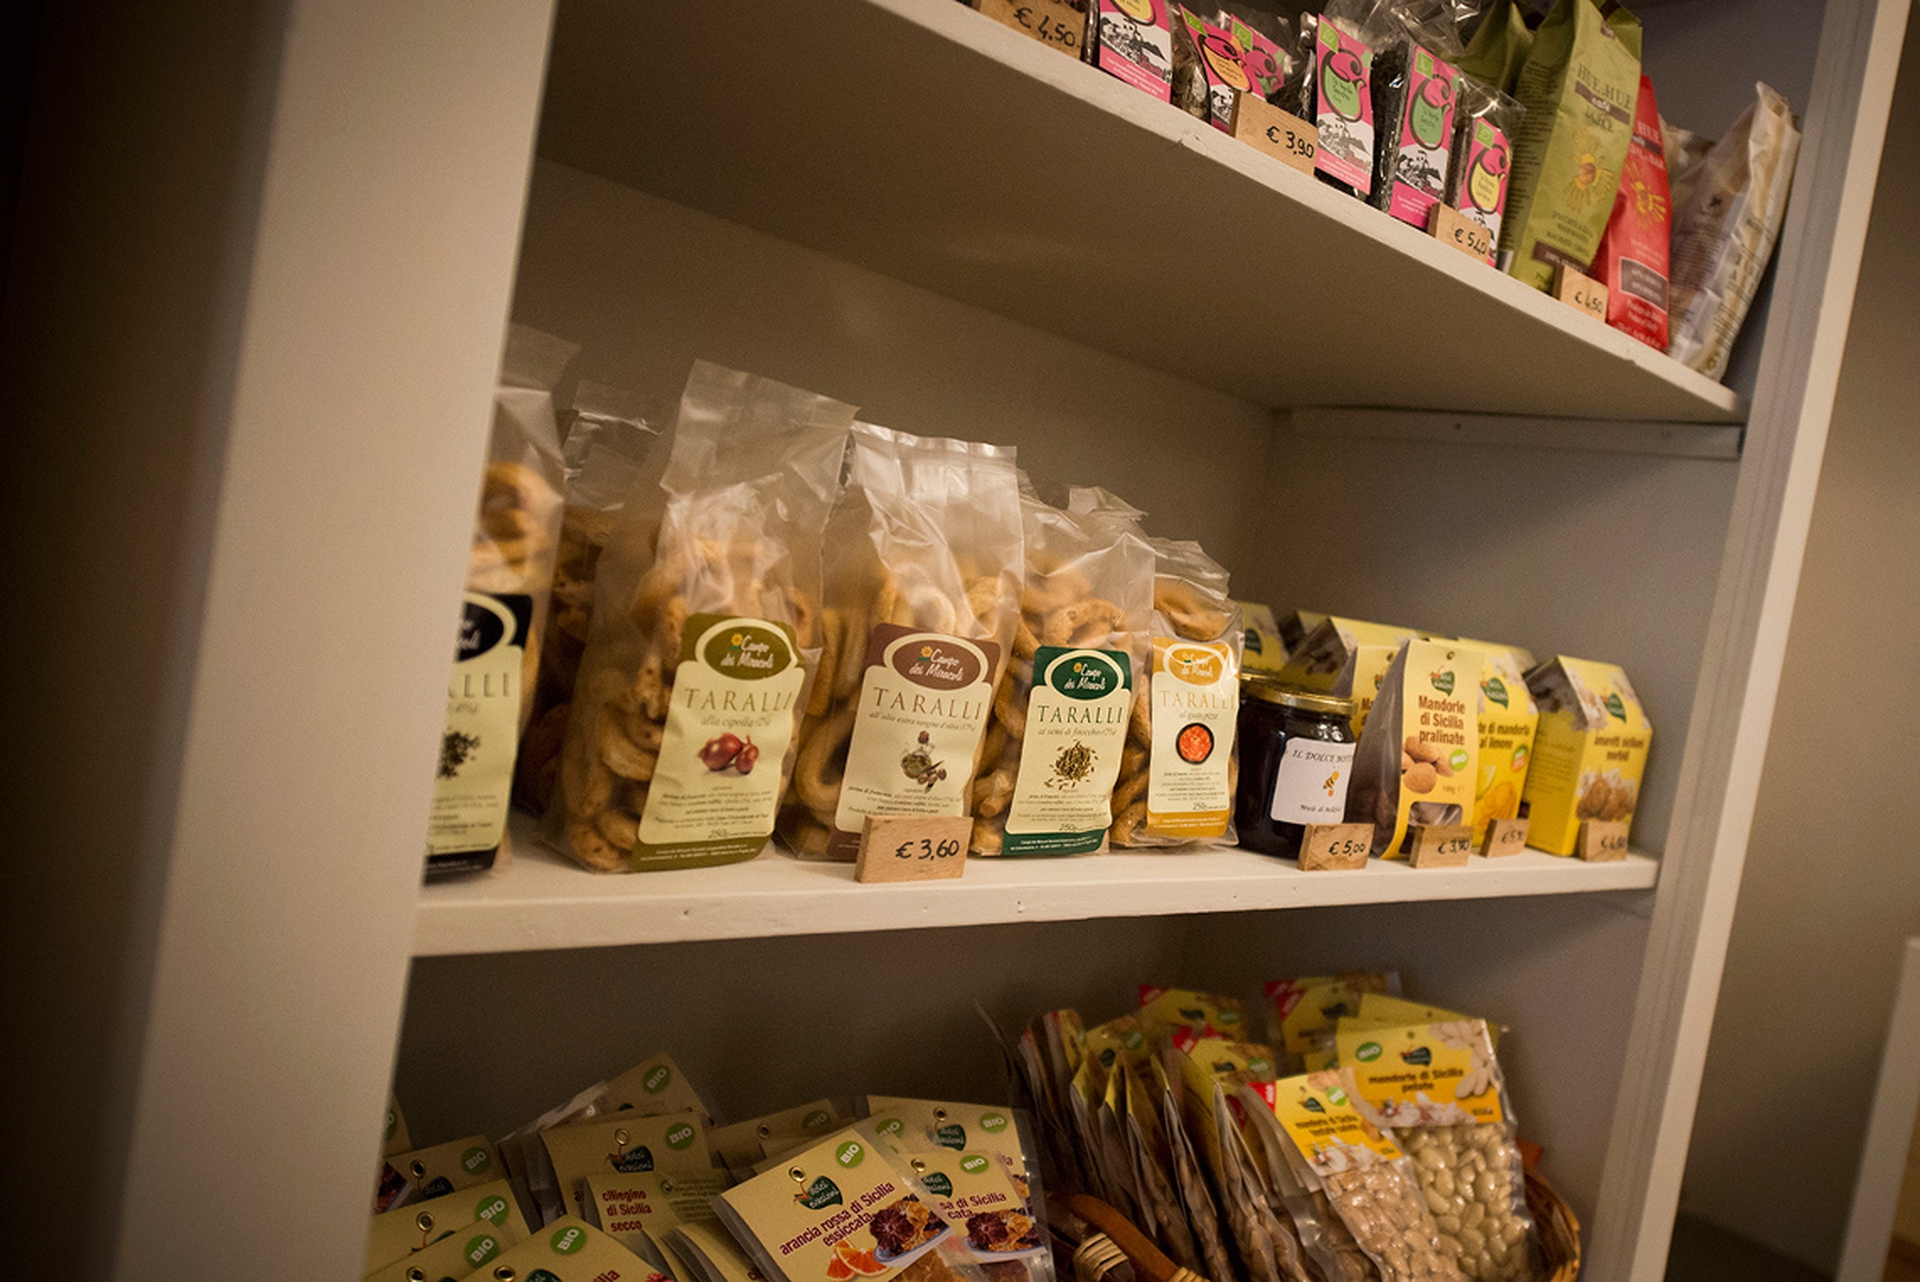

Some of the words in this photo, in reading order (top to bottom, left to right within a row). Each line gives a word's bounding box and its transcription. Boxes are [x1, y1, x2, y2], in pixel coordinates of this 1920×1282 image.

[1013, 7, 1032, 29] €
[1265, 124, 1281, 144] €
[1285, 130, 1315, 159] 3,90
[1454, 227, 1464, 244] €
[684, 688, 793, 713] TARALLI
[874, 686, 982, 720] TARALLI
[1158, 690, 1235, 711] TARALLI
[1418, 695, 1466, 715] Mandorle
[1037, 705, 1122, 724] TARALLI
[1420, 711, 1431, 726] di
[1432, 712, 1465, 731] Sicilia
[1419, 729, 1466, 747] pralinate
[895, 840, 914, 860] €
[917, 838, 960, 862] 3,60
[1328, 841, 1340, 856] €
[1341, 839, 1367, 858] 5,00
[645, 1066, 667, 1090] BIO
[982, 1117, 1006, 1130] BIO
[669, 1125, 693, 1145] BIO
[464, 1149, 488, 1171] BIO
[838, 1143, 861, 1165] BIO
[963, 1157, 985, 1172] BIO
[606, 1204, 618, 1217] di
[619, 1204, 652, 1217] Sicilia
[956, 1196, 968, 1210] di
[968, 1192, 1007, 1207] Sicilia
[610, 1219, 643, 1232] secco
[779, 1224, 823, 1257] arancia
[820, 1208, 853, 1233] rossa
[850, 1199, 864, 1215] di
[859, 1180, 896, 1208] Sicilia
[556, 1227, 580, 1252] BIO
[821, 1211, 875, 1249] essiccata
[470, 1237, 495, 1263] BIO
